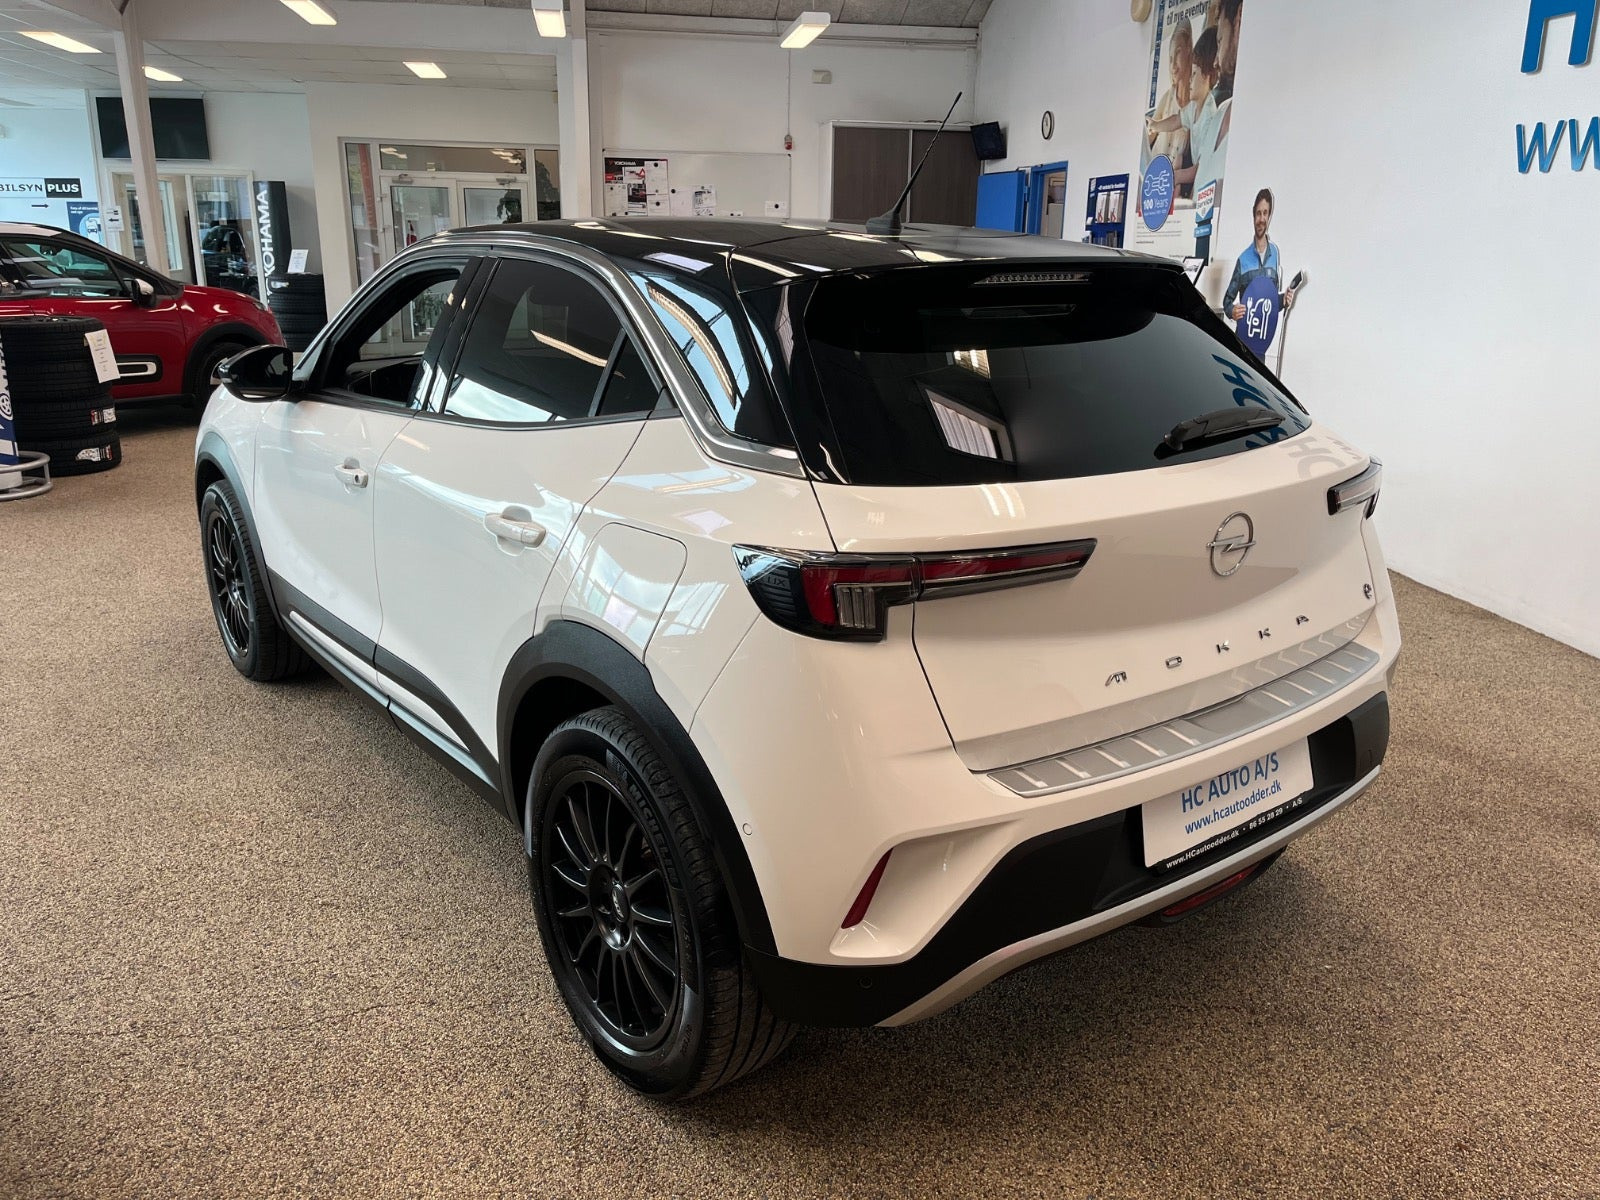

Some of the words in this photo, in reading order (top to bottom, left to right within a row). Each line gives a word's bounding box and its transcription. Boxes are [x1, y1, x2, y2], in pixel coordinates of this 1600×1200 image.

[47, 183, 79, 192] PLUS
[1143, 199, 1154, 210] 100
[1198, 186, 1214, 200] BOSCH
[1105, 615, 1309, 687] MOKKA
[1181, 786, 1204, 812] HC
[1208, 766, 1250, 801] AUTO
[1254, 752, 1279, 780] A/S
[1185, 779, 1282, 834] www.hcautoodder.dk
[1166, 829, 1240, 869] www.HCautoodder.dk
